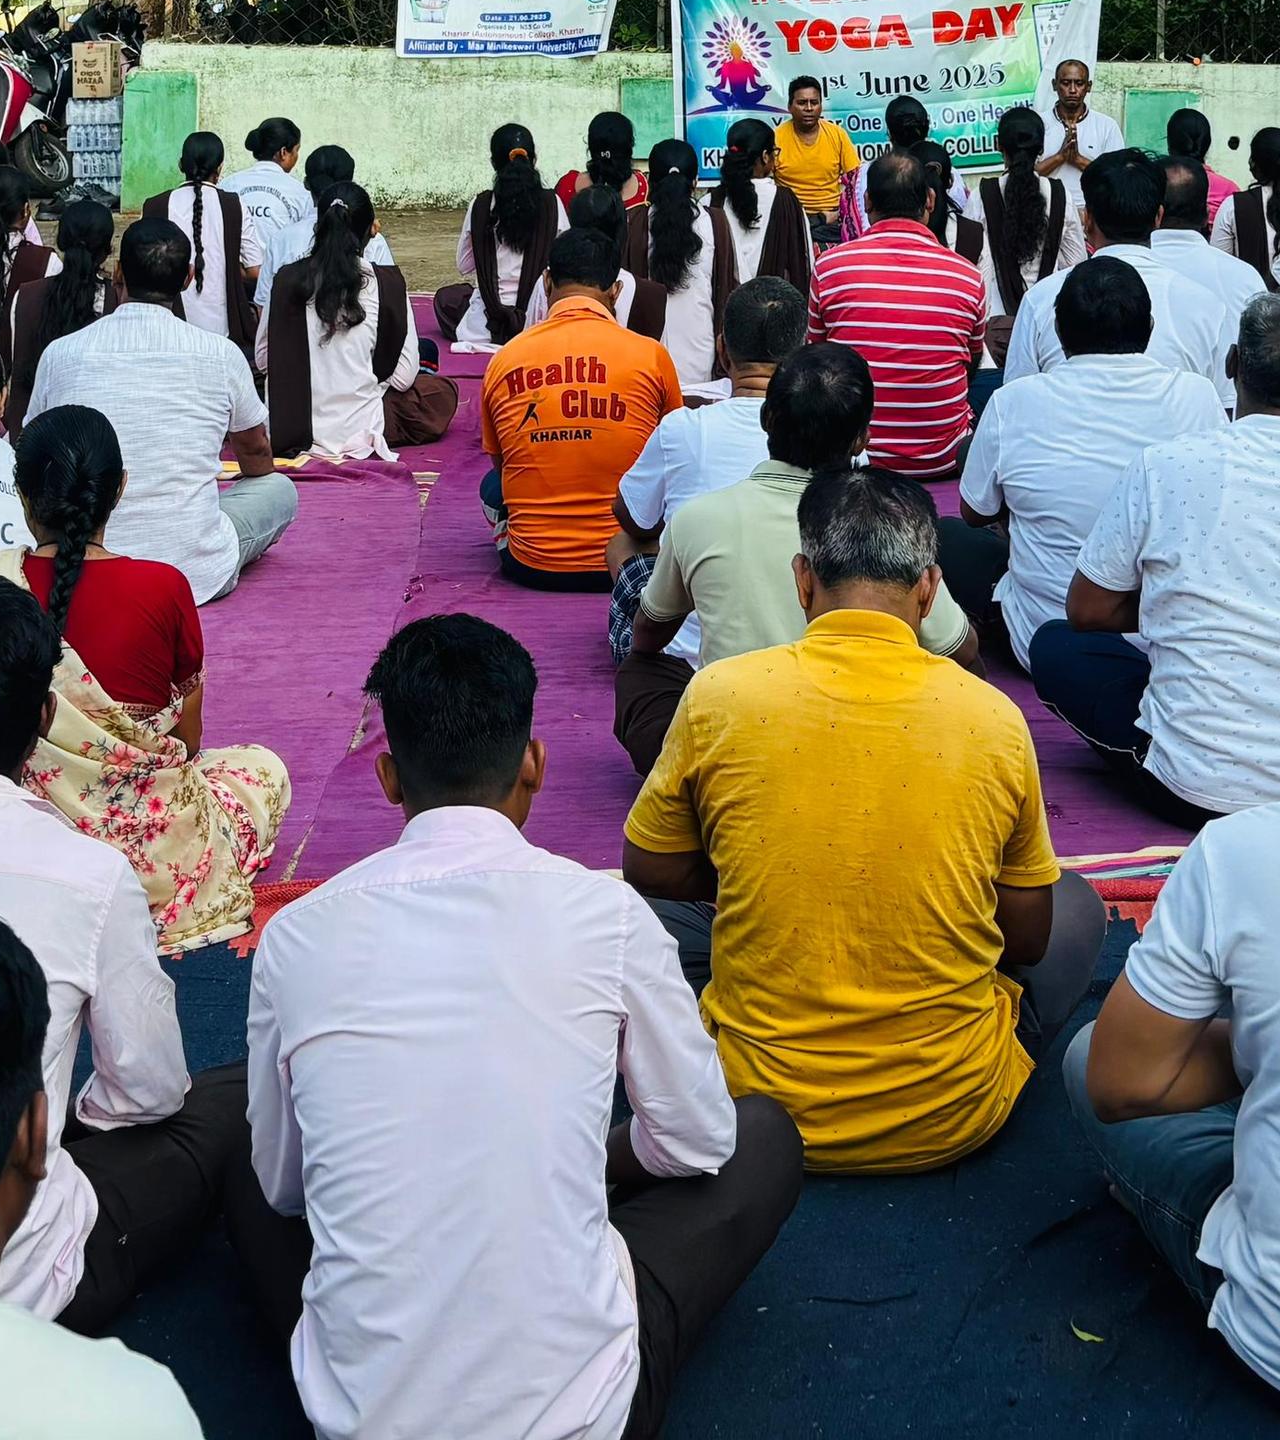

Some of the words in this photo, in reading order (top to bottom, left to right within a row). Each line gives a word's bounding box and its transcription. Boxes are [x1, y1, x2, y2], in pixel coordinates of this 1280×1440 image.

[774, 13, 915, 55] YOGA
[932, 2, 1025, 46] DAY
[408, 41, 445, 51] Affiliated
[447, 41, 458, 52] By
[468, 41, 485, 50] Maa
[856, 71, 932, 98] June
[939, 62, 1007, 91] 2025
[847, 114, 882, 131] One
[942, 107, 976, 124] One
[505, 355, 607, 400] Health
[560, 389, 627, 423] Club
[530, 429, 592, 443] KHARIAR
